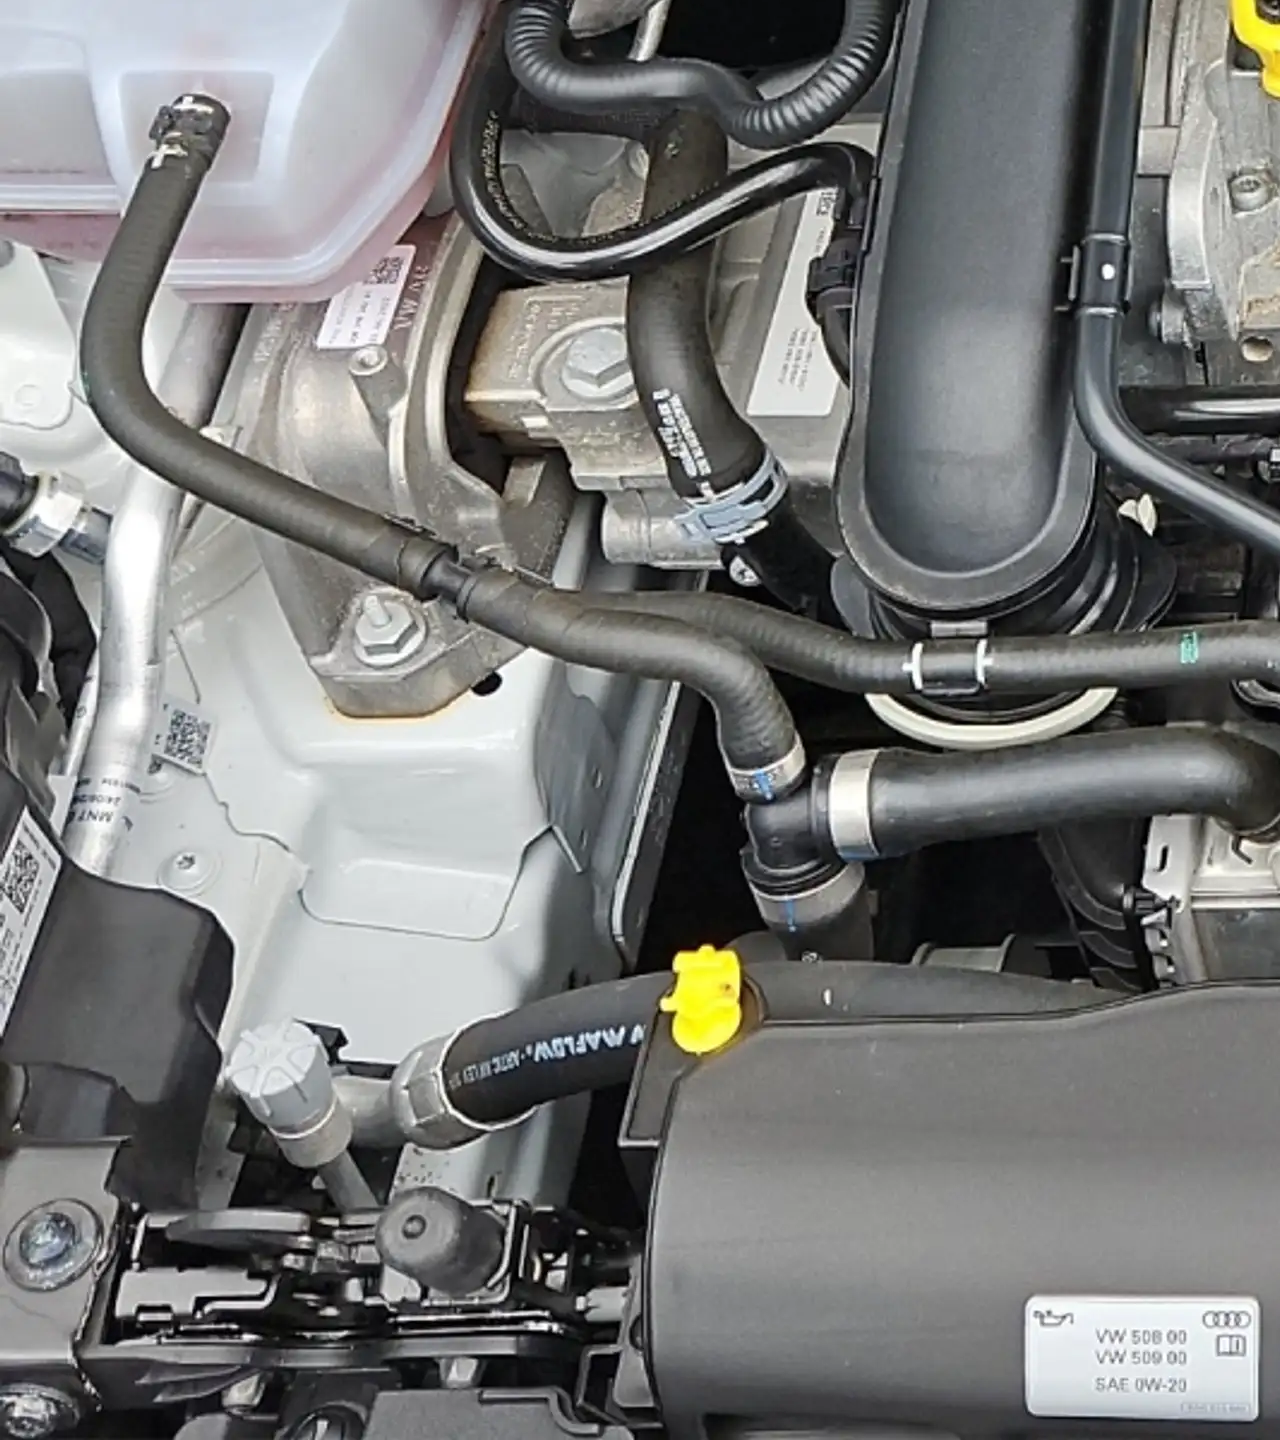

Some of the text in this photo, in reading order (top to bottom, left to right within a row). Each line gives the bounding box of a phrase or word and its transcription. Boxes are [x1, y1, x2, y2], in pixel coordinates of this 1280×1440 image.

[1095, 1328, 1188, 1345] VW 508 00
[1095, 1349, 1188, 1366] VW 509 00
[1095, 1377, 1188, 1394] SAE 0W-20
